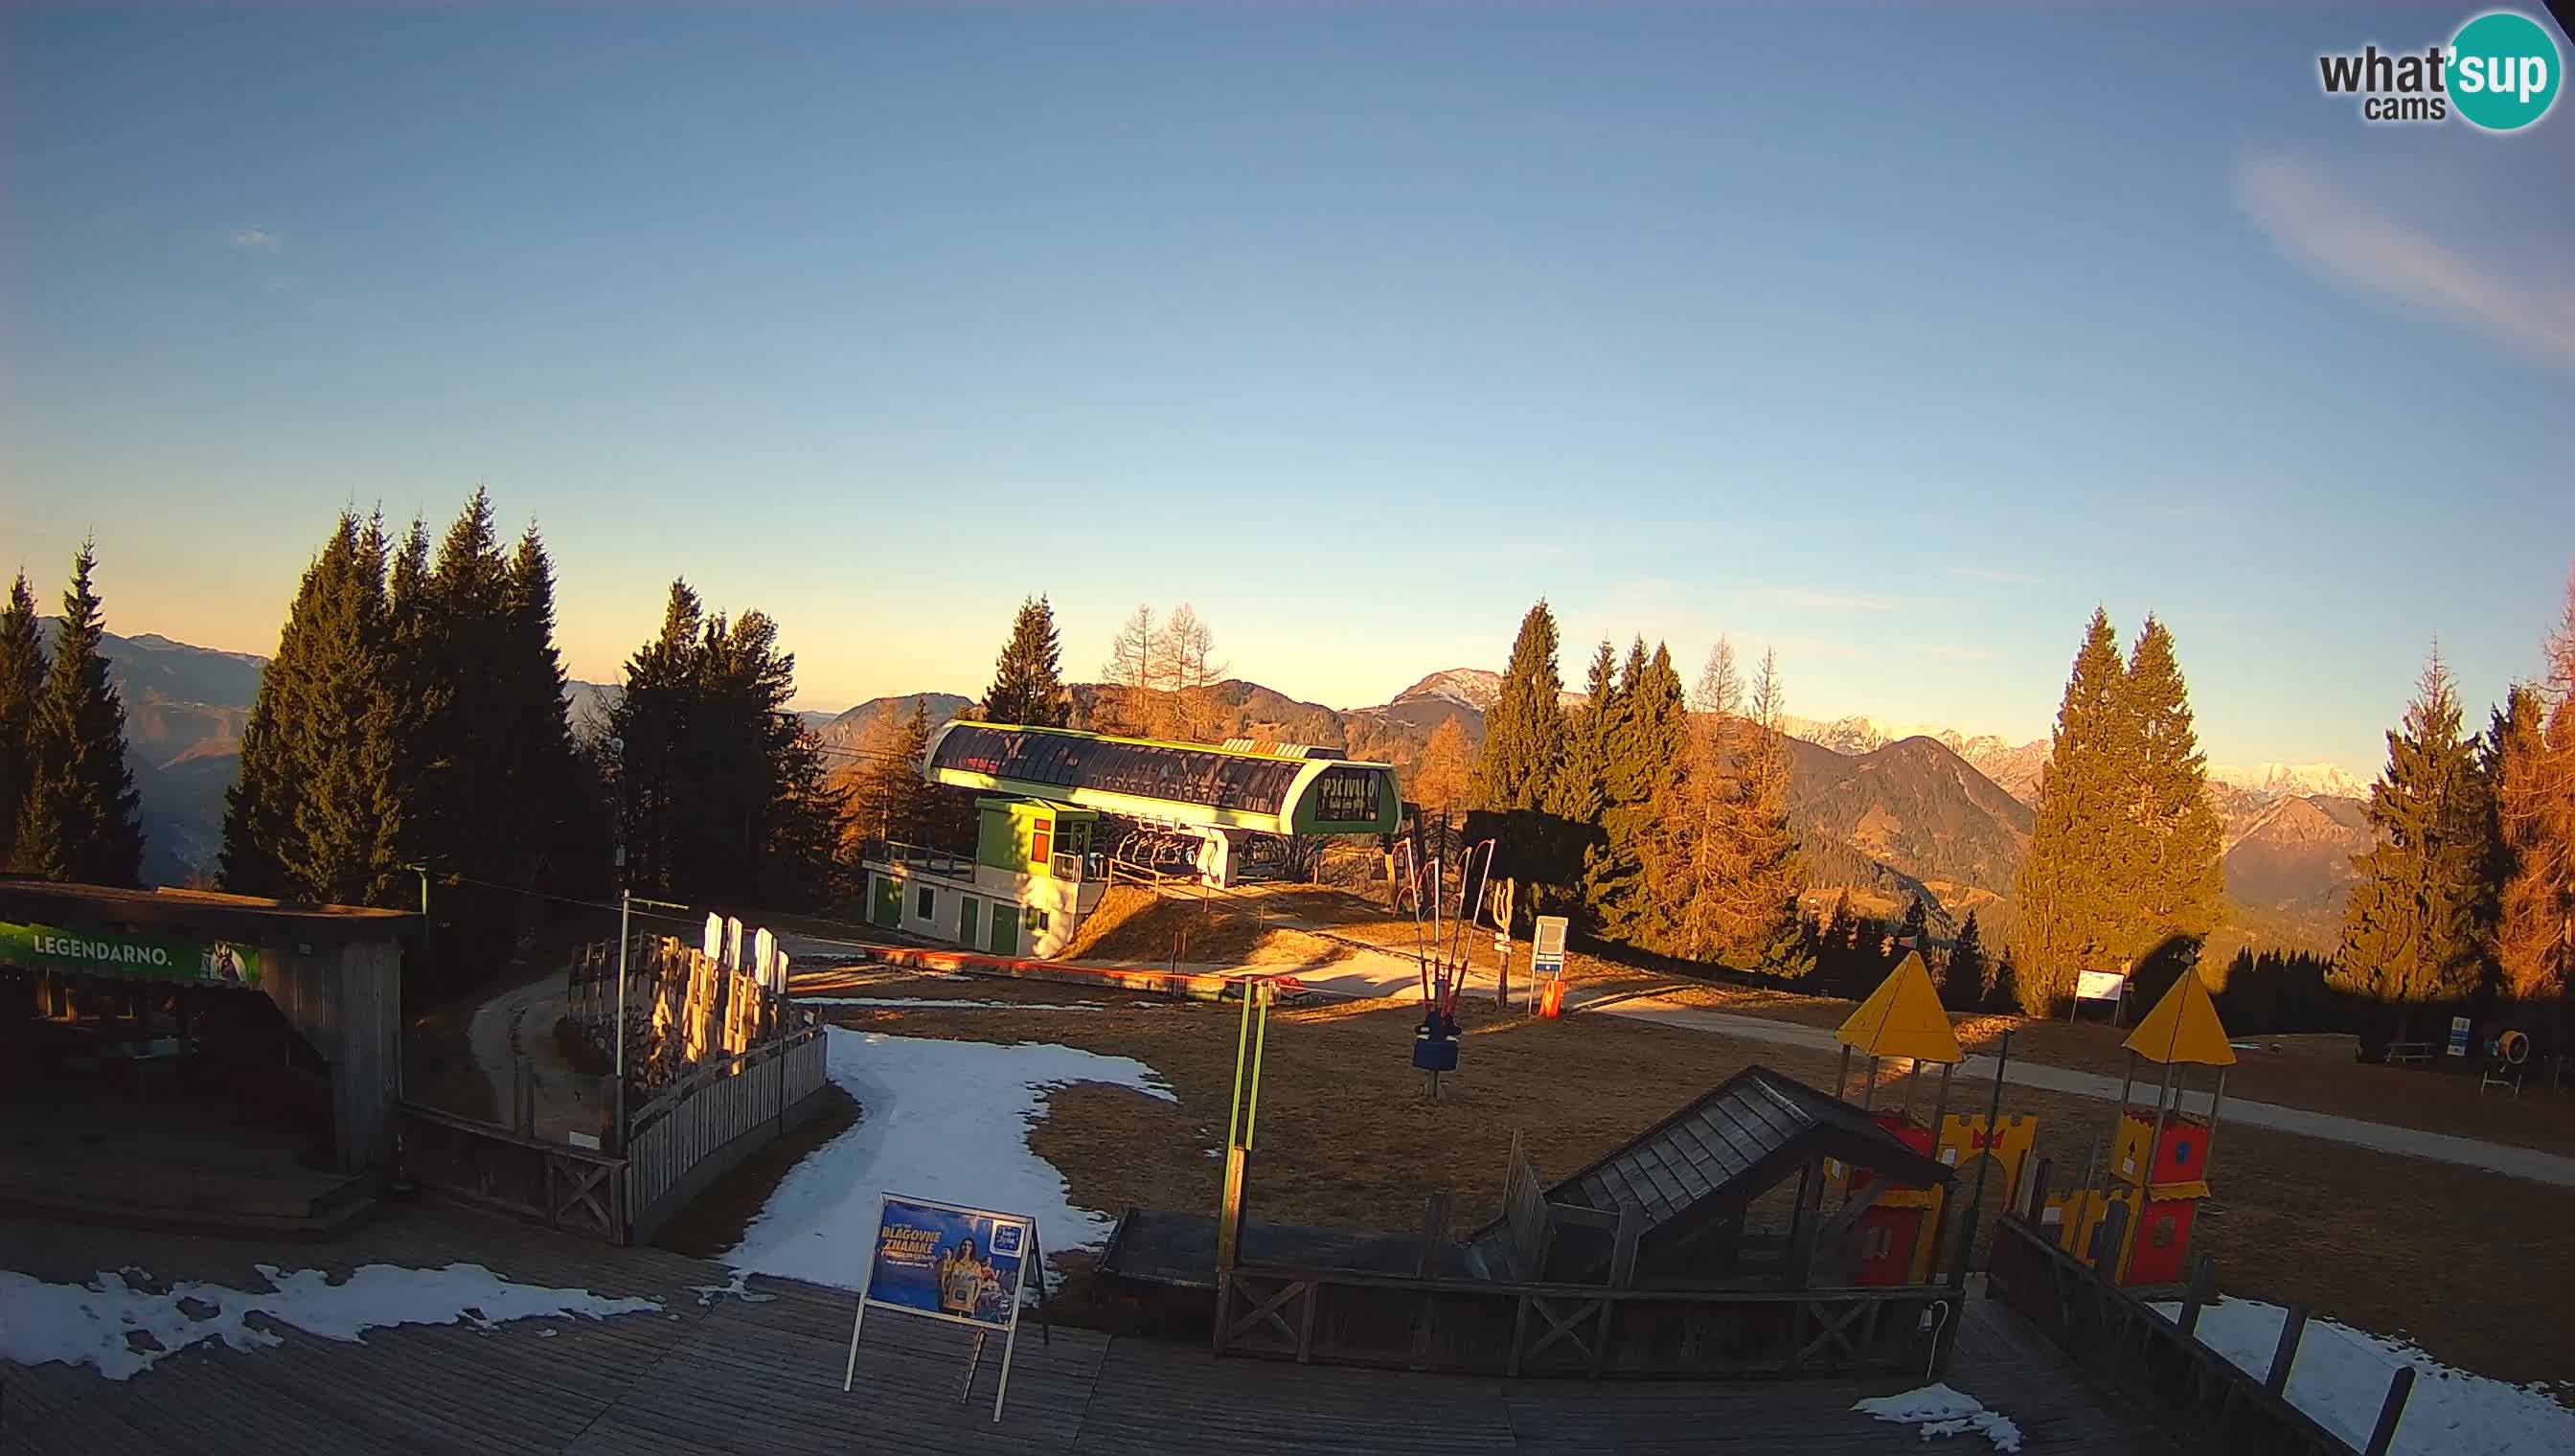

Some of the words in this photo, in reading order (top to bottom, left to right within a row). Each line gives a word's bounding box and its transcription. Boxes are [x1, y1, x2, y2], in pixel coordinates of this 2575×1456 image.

[34, 934, 173, 967] LEGENDARNO.
[881, 1226, 943, 1243] BLAGOVNE
[882, 1239, 936, 1254] ZNAMKE
